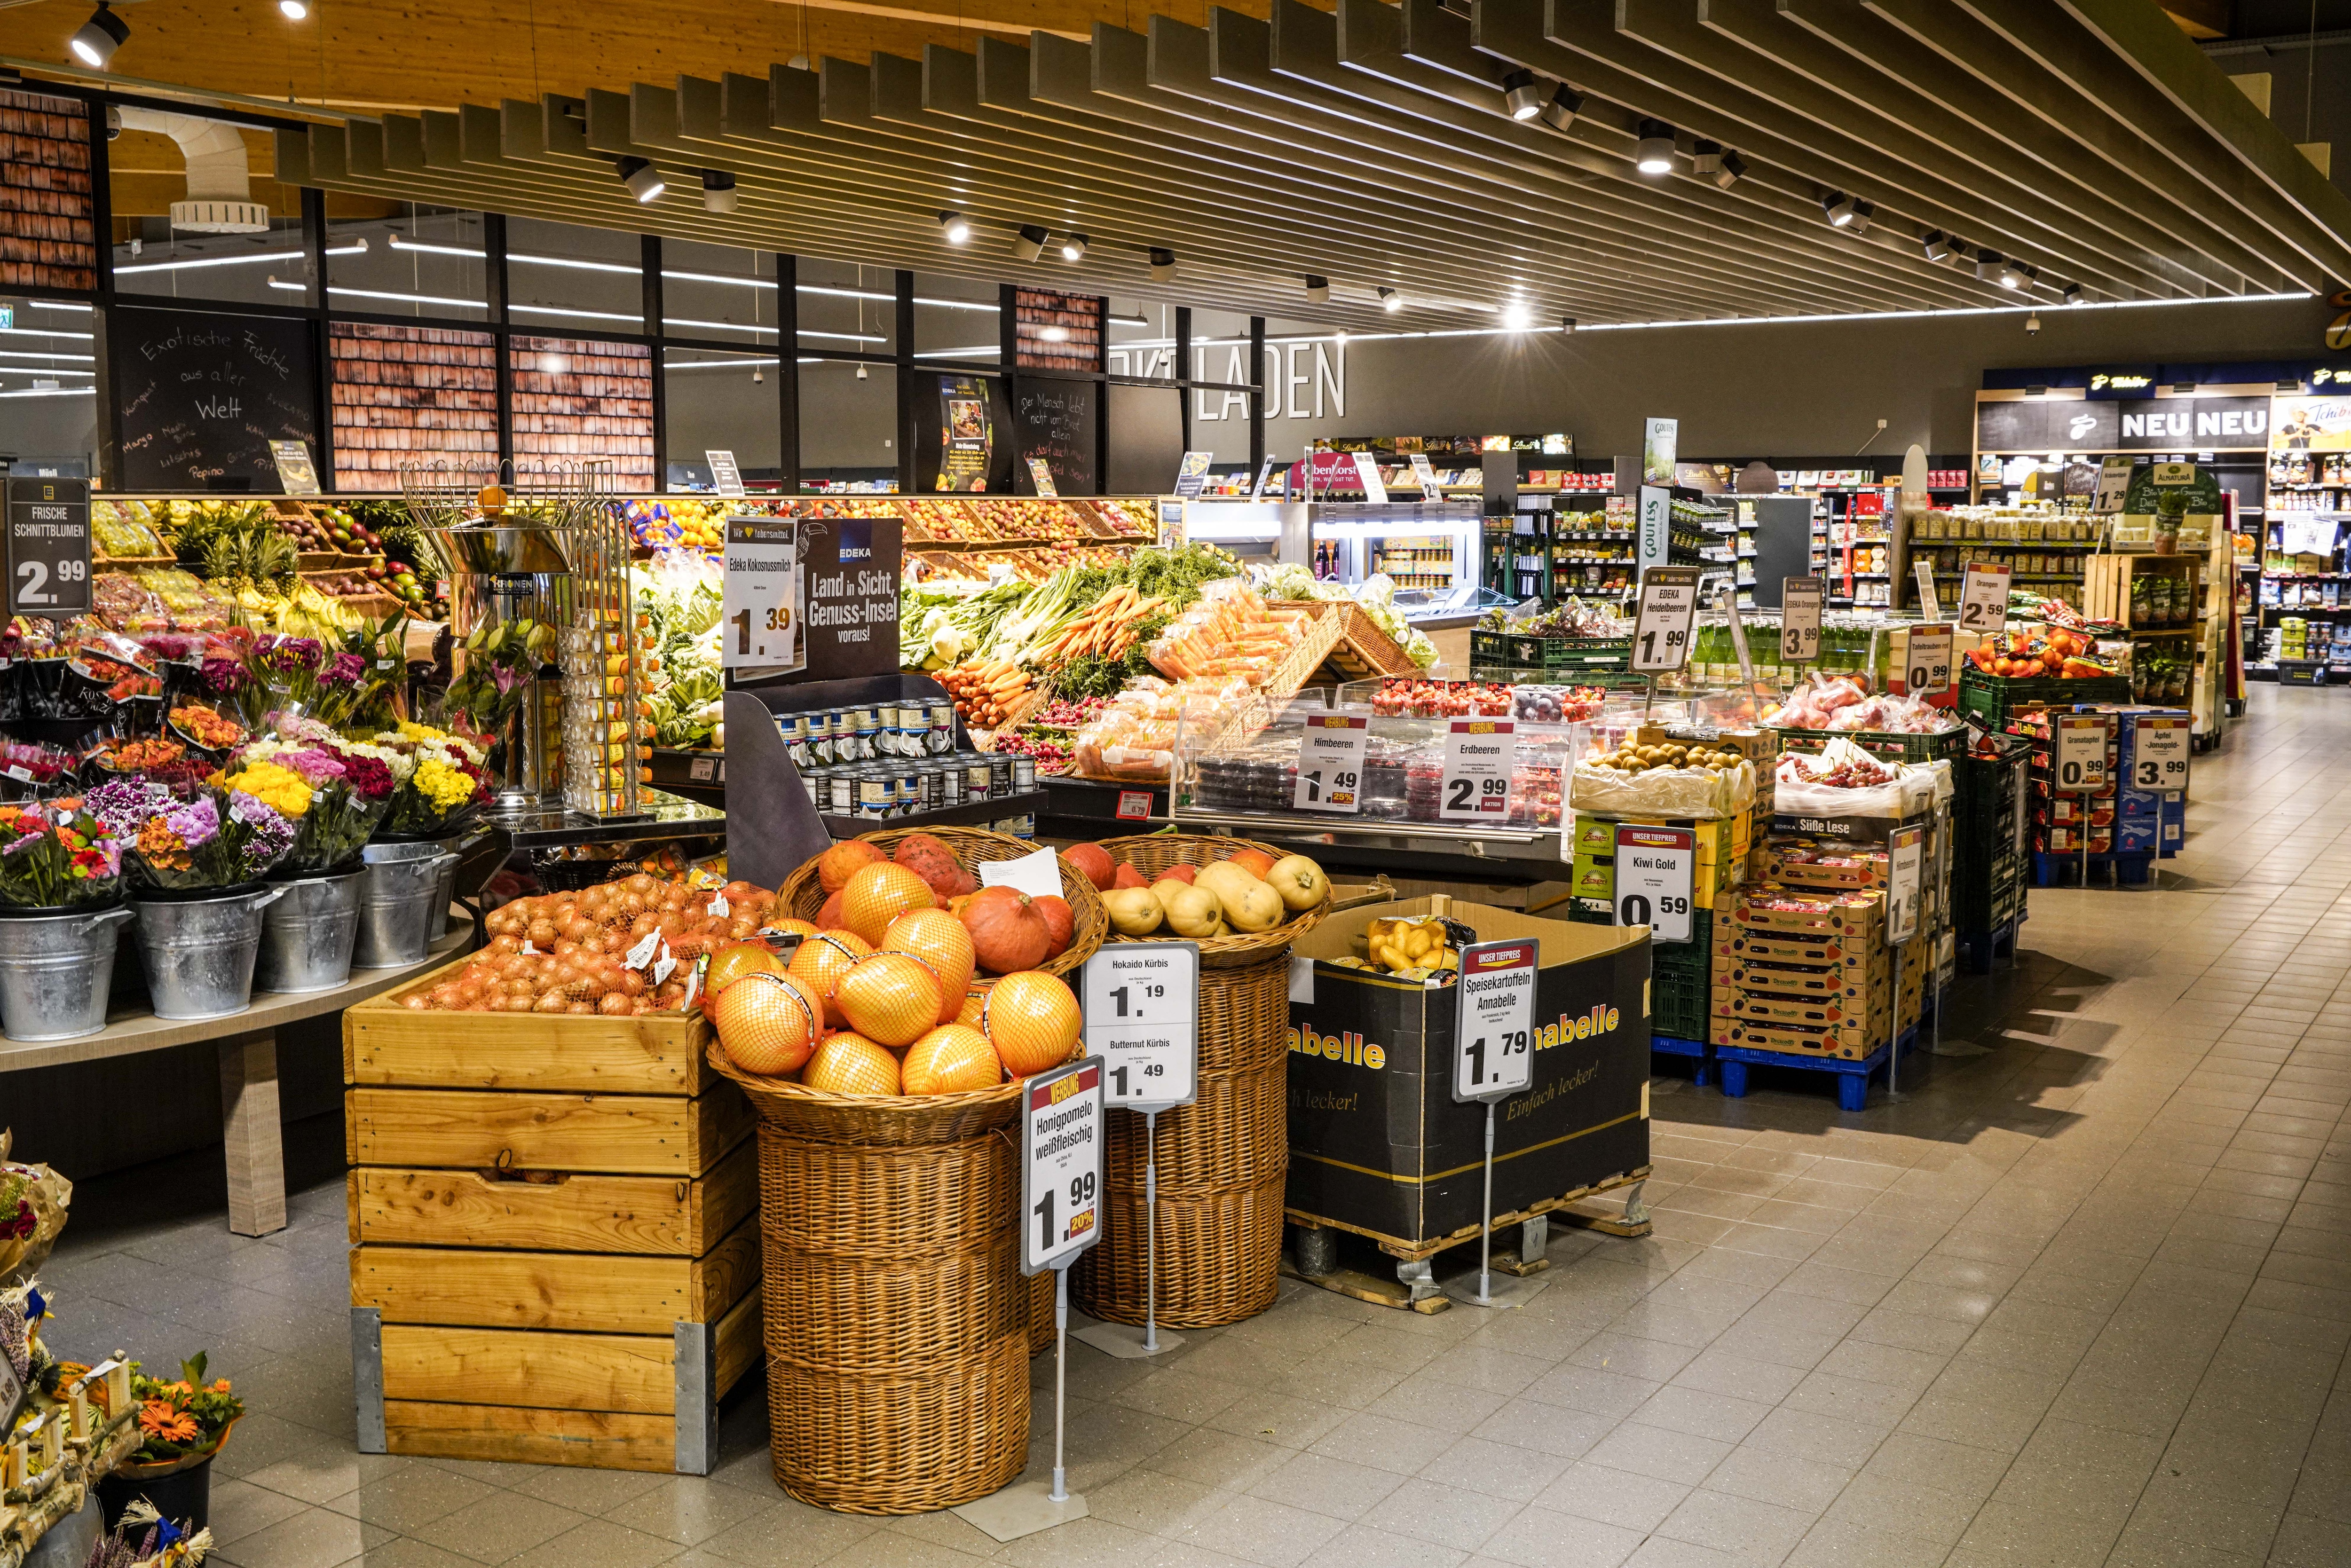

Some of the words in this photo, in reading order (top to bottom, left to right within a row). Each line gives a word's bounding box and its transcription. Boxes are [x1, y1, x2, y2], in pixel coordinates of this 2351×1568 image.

[141, 326, 230, 361] Exotische
[244, 330, 289, 380] Früchte
[181, 370, 203, 381] aus
[211, 361, 246, 386] aller
[195, 395, 242, 419] Welt
[1037, 393, 1064, 409] Mensch
[1068, 394, 1084, 415] lebt
[1031, 410, 1047, 425] nicht
[2122, 413, 2189, 437] NEU
[2197, 410, 2266, 436] NEU
[1051, 427, 1071, 441] allein
[1655, 423, 1674, 434] GOUTESS
[122, 433, 153, 453] Mango
[1036, 441, 1052, 457] darf
[1053, 444, 1069, 457] auch
[1343, 443, 1362, 452] Lindt
[1426, 443, 1446, 451] Lindt
[1513, 441, 1534, 450] Lindt
[39, 468, 58, 477] Müsli
[189, 465, 224, 481] Pepino
[1049, 463, 1064, 475] pfel
[1301, 465, 1357, 475] Rbenorst
[1685, 469, 1704, 478] Lindt
[32, 507, 67, 520] FRISCHE
[15, 524, 84, 537] SCHNITTBLUMEN
[734, 528, 743, 537] Wir
[755, 529, 789, 539] Lebensmittel.
[1645, 500, 1658, 558] GOUTESS
[839, 548, 871, 558] EDEKA
[730, 558, 746, 571] Edeka
[748, 558, 790, 572] Kokosnussmilch
[493, 580, 532, 588] KRONEN
[813, 571, 844, 598] Land
[847, 580, 854, 596] in
[858, 570, 895, 598] Sicht,
[1977, 580, 1998, 589] Orangen
[1659, 589, 1679, 599] EDEKA
[1647, 602, 1687, 613] Heidelbeeren
[1802, 600, 1818, 609] Orangen
[809, 597, 897, 627] Genuss-Insel
[837, 625, 870, 643] voraus!
[1325, 716, 1349, 728] WERBUNG
[1469, 721, 1495, 734] WERBUNG
[2019, 722, 2036, 736] Laila
[2067, 736, 2099, 744] Granatapfel
[2154, 732, 2171, 740] Äpfel
[1314, 738, 1354, 749] Himbeeren
[1460, 745, 1500, 754] Erdbeeren
[2145, 741, 2180, 750] -Jonagold-
[1333, 793, 1353, 801] 25%
[1800, 818, 1824, 832] Süße
[1827, 820, 1850, 834] Lese
[1583, 832, 1609, 843] Zespri
[1633, 832, 1650, 841] UNSER
[1651, 834, 1677, 842] TIEFPREIS
[1633, 857, 1652, 868] Kiwi
[1656, 859, 1675, 870] Gold
[1580, 875, 1608, 886] Zespri
[1478, 953, 1495, 963] UNSER
[1497, 949, 1521, 961] TIEFPREIS
[1112, 960, 1143, 969] Hokaido
[1145, 959, 1168, 968] Kürbis
[1466, 972, 1530, 995] Speisekartoffeln
[1477, 993, 1516, 1011] Annabelle
[1534, 1003, 1619, 1051] nabelle
[1110, 1040, 1144, 1049] Butternut
[1147, 1039, 1170, 1048] Kürbis
[1286, 1022, 1386, 1070] abelle
[1050, 1071, 1079, 1106] WERBUNG
[1507, 1083, 1554, 1121] Einfach
[1559, 1059, 1599, 1095] lecker!
[1306, 1090, 1357, 1111] lecker!
[1037, 1100, 1092, 1136] Honigpomelo
[1036, 1124, 1092, 1160] weißfleischig
[1072, 1210, 1093, 1231] 20%
